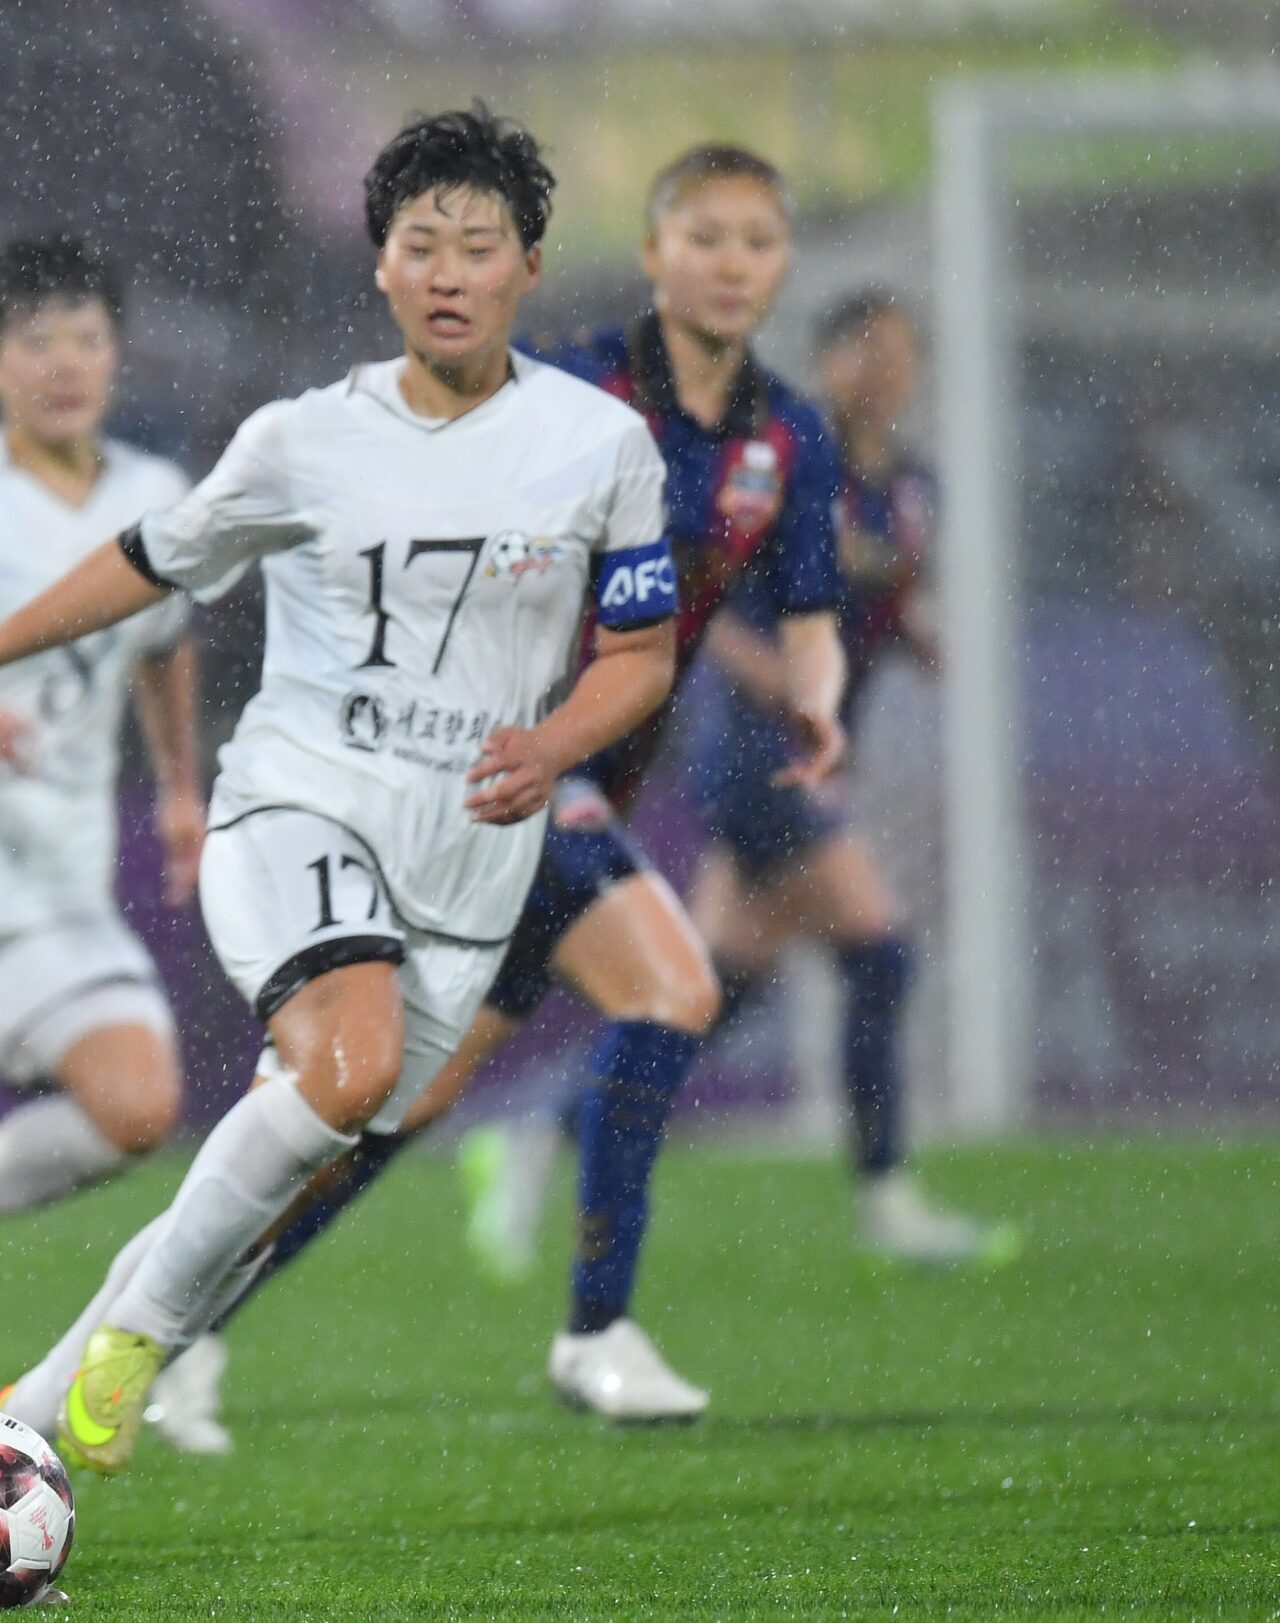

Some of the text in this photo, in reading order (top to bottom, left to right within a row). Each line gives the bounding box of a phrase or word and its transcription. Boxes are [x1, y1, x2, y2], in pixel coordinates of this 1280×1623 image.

[354, 538, 487, 675] 17
[601, 555, 674, 607] AFC
[306, 853, 379, 933] 17
